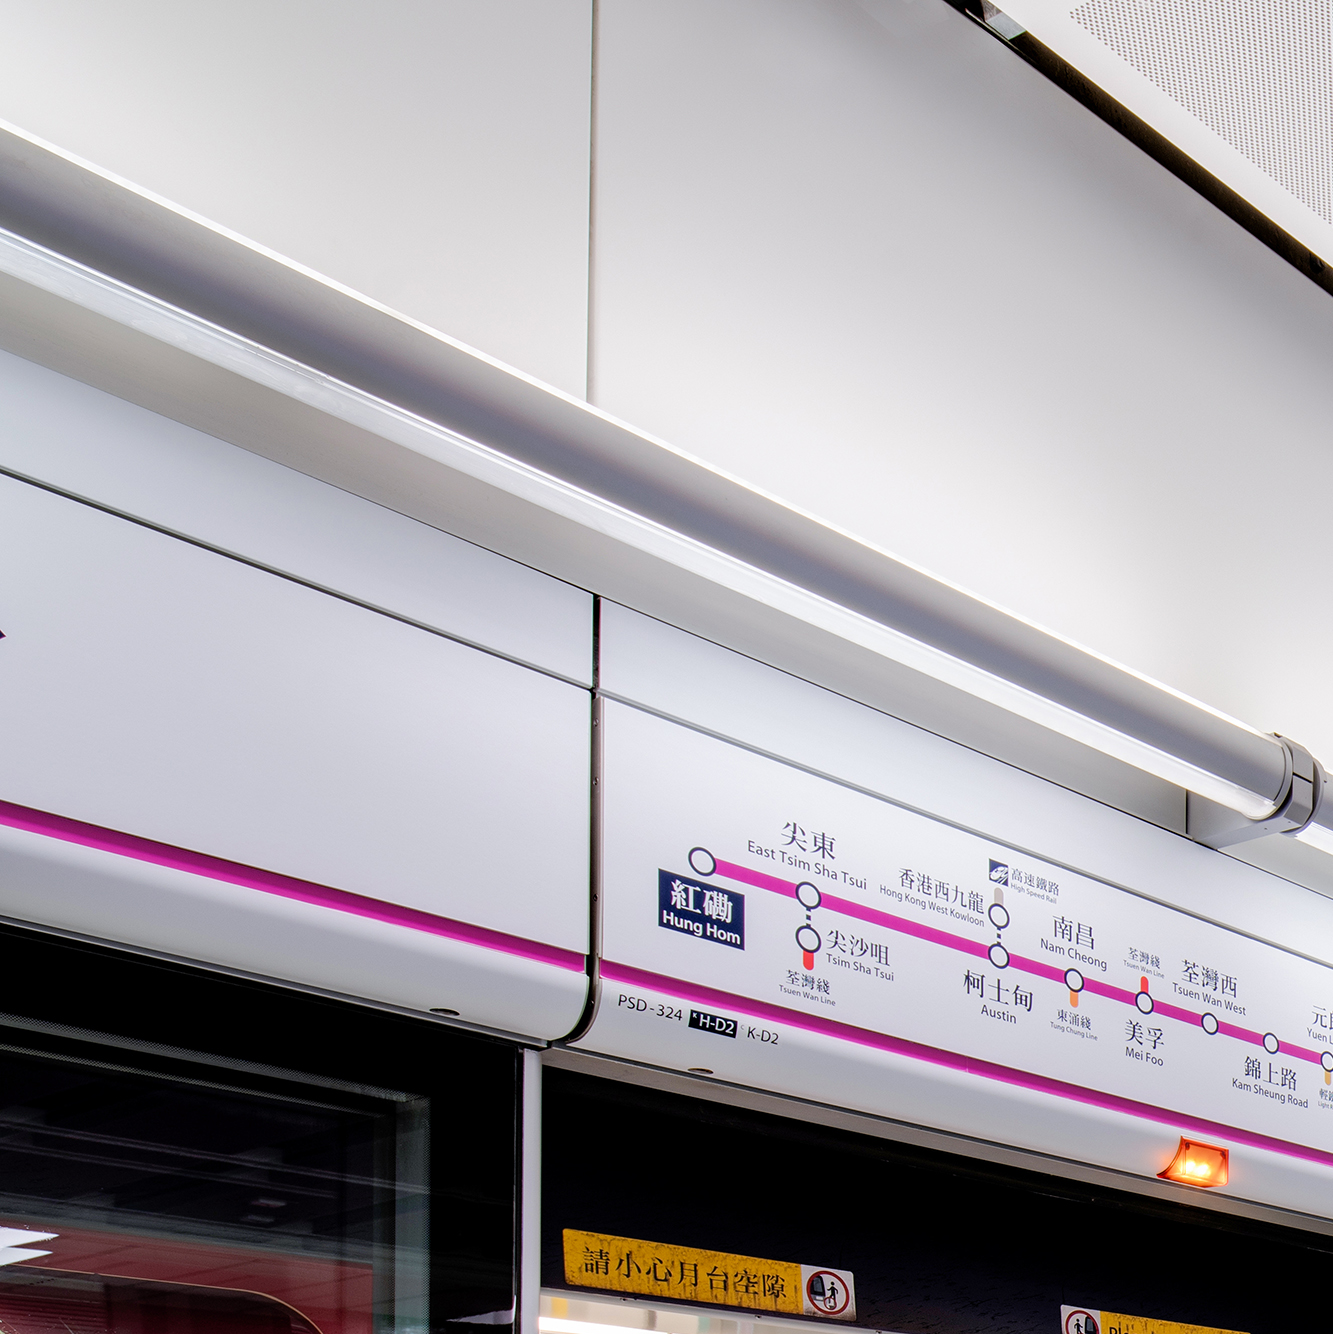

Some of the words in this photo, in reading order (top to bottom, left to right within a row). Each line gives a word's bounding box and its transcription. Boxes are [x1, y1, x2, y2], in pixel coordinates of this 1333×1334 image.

[781, 822, 836, 860] 尖東
[748, 840, 775, 860] East
[780, 851, 810, 872] Tsim
[815, 862, 837, 880] Sha
[841, 872, 867, 890] Tsui
[1011, 868, 1059, 896] 高速鐵路
[671, 879, 733, 923] 紅磡
[880, 884, 902, 902] Hong
[905, 892, 926, 910] Kong
[929, 902, 948, 916] West
[950, 908, 984, 927] Kowloon
[899, 868, 984, 915] 香港西九龍
[1011, 883, 1025, 895] High
[1026, 889, 1044, 901] Speed
[1045, 894, 1057, 904] Rail
[663, 910, 702, 936] Hung
[706, 923, 741, 945] Hom
[1053, 915, 1094, 950] 南昌
[826, 930, 890, 967] 尖沙咀
[1041, 938, 1064, 956] Nam
[1068, 948, 1107, 972] Cheong
[826, 953, 850, 969] Tsim
[853, 962, 871, 975] Sha
[874, 968, 894, 982] Tsui
[1123, 959, 1139, 970] Tsuen
[1140, 965, 1153, 975] Wan
[1154, 970, 1164, 979] Line
[1181, 959, 1237, 998] 荃灣西
[779, 985, 801, 997] Tsuen
[803, 991, 819, 1002] Wan
[821, 995, 836, 1007] Line
[963, 969, 1033, 1012] 柯士甸
[1172, 982, 1200, 1000] Tsuen
[1202, 992, 1222, 1008] Wan
[1224, 1000, 1246, 1016] West
[981, 1005, 1016, 1024] Austin
[1050, 1021, 1064, 1034] Tung
[1066, 1026, 1085, 1038] Chung
[1086, 1032, 1098, 1041] Line
[1125, 1019, 1164, 1050] 美孚
[1307, 1027, 1327, 1042] Yuen
[1125, 1047, 1143, 1061] Mei
[1146, 1053, 1163, 1066] Foo
[1244, 1056, 1297, 1091] 錦上路
[1232, 1078, 1251, 1092] Kam
[1253, 1084, 1285, 1104] Sheung
[1288, 1094, 1308, 1108] Road
[582, 1246, 787, 1299] 請小心月台空隙
